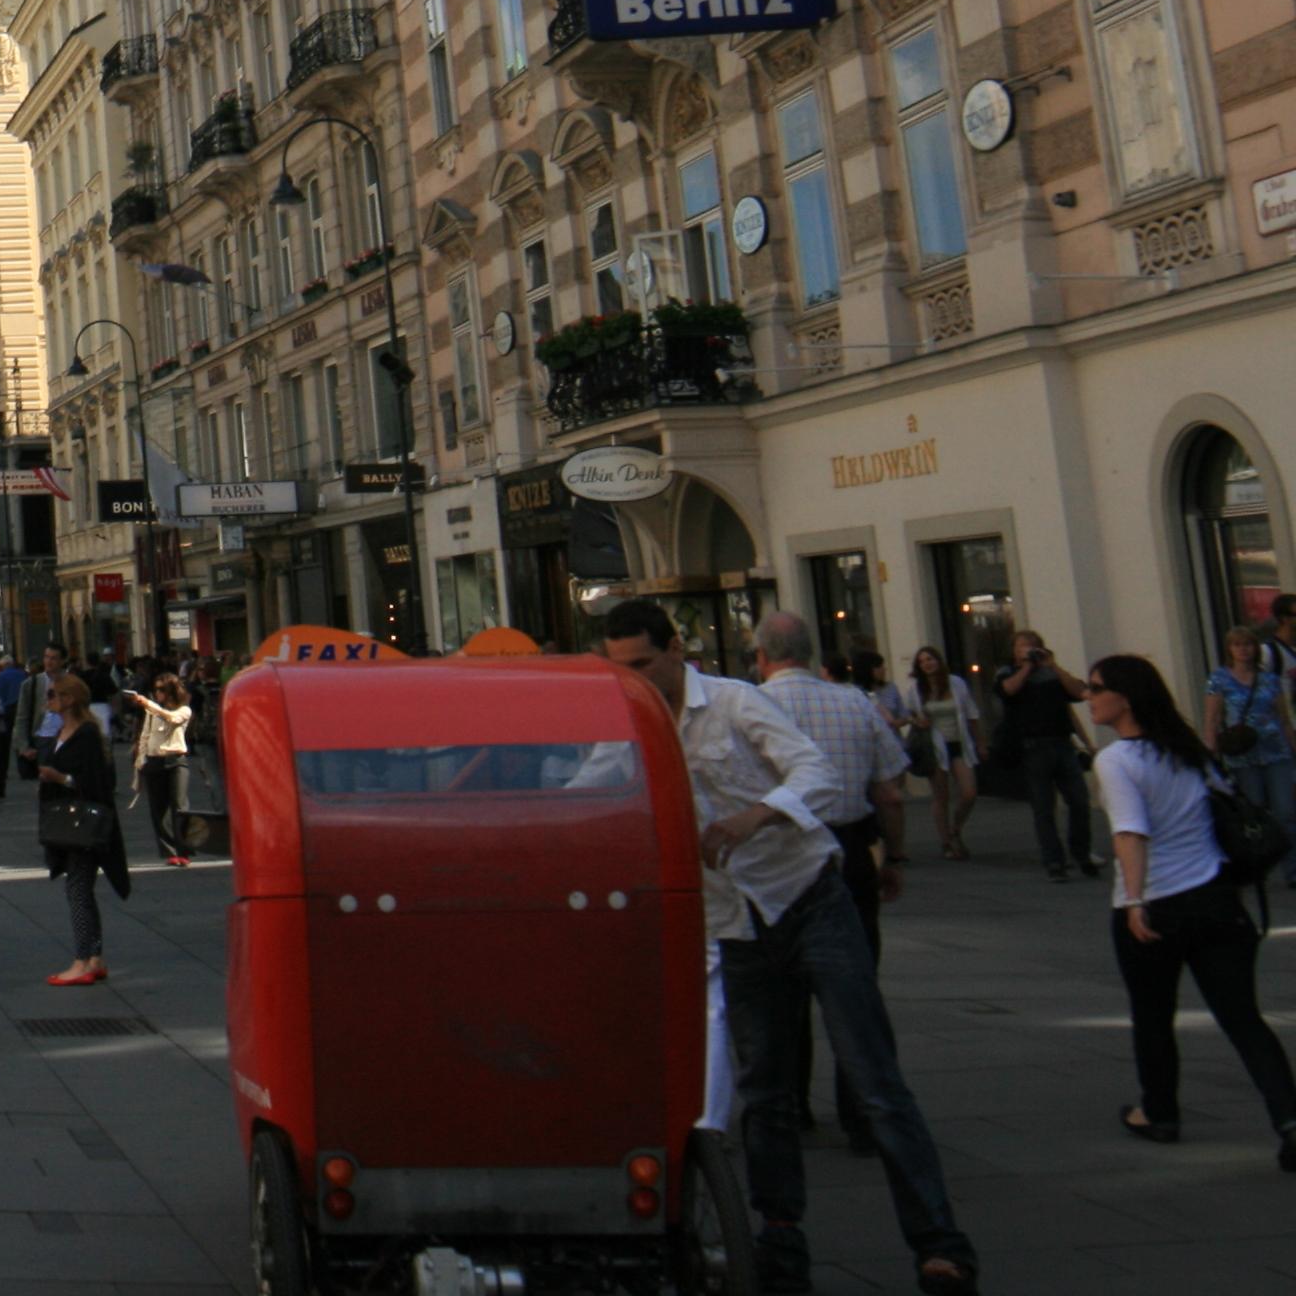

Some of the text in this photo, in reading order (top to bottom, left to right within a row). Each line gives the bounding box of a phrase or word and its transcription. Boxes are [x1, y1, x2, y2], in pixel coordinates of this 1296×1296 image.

[831, 438, 938, 489] HELDWEIN
[362, 472, 403, 484] BALLY
[568, 463, 664, 484] Albin Denk
[211, 484, 264, 499] HABAN
[507, 482, 551, 511] KNIZE
[297, 643, 378, 661] FAXI
